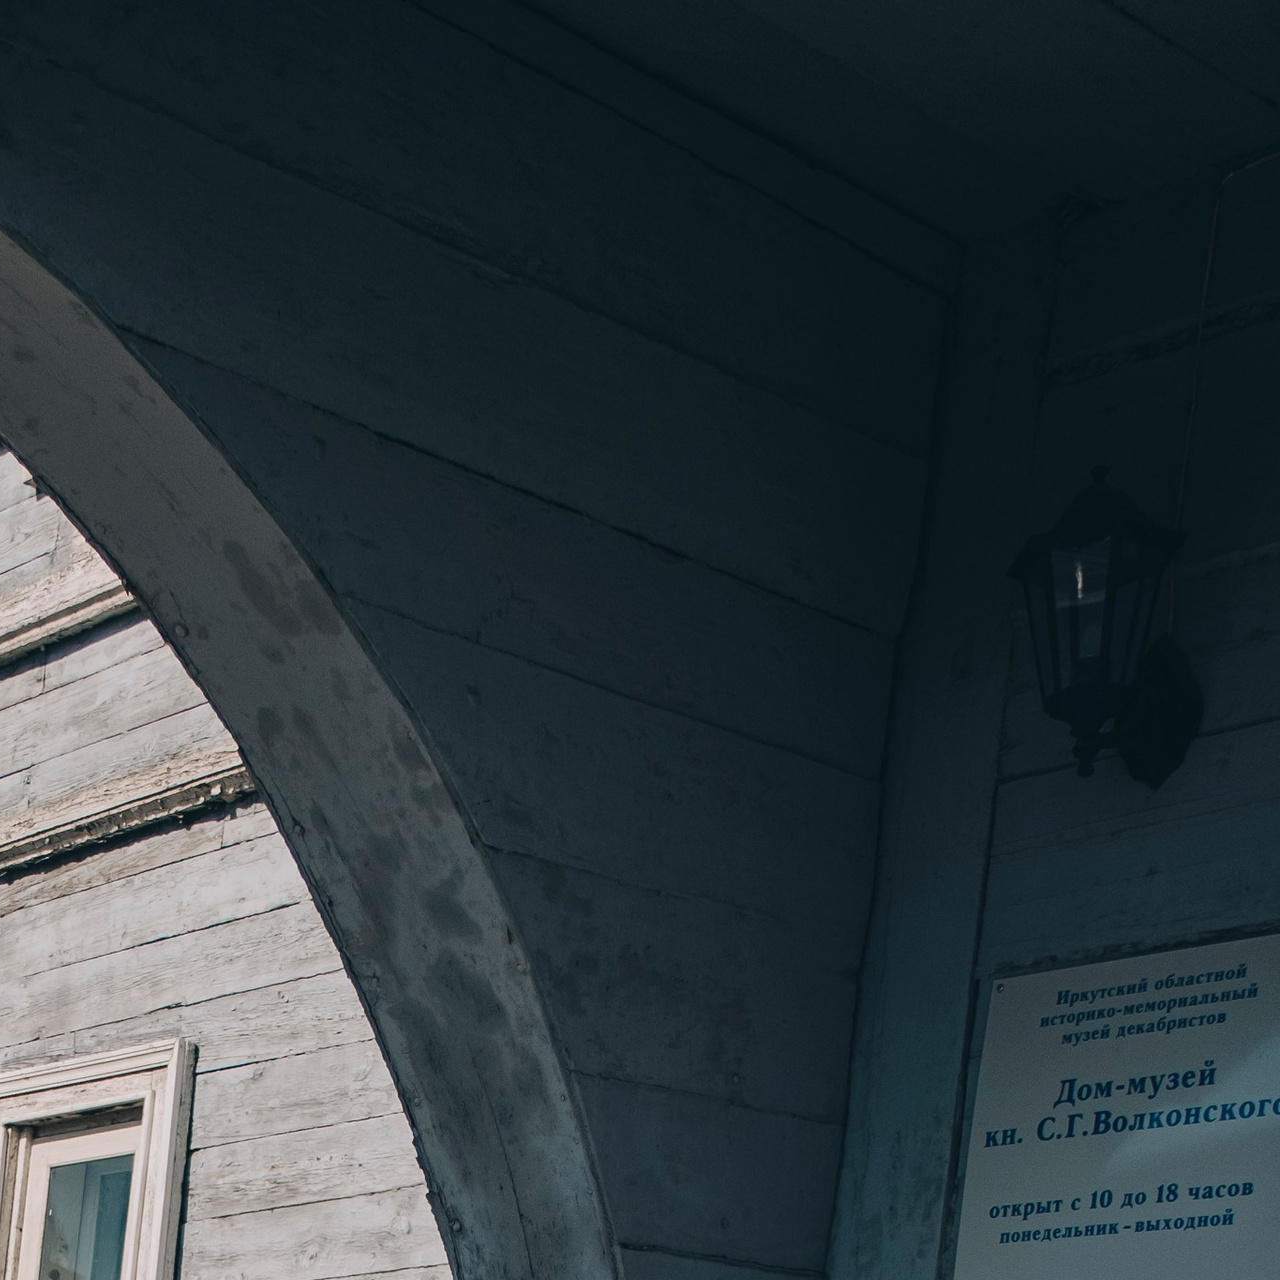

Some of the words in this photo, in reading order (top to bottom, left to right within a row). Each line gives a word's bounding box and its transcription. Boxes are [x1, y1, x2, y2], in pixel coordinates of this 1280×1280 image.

[1039, 983, 1259, 1028] историко-мемориальный
[1055, 978, 1148, 1007] Иркутский
[1154, 963, 1248, 992] областной
[1061, 1022, 1111, 1046] музей
[1115, 1011, 1227, 1039] декабристов
[1053, 1060, 1217, 1109] Дом-музей
[984, 1127, 1024, 1148] кн.
[989, 1200, 1063, 1221] открыт
[1070, 1198, 1081, 1211] с
[1089, 1189, 1113, 1209] 10
[1121, 1191, 1147, 1208] до
[1156, 1184, 1179, 1203] 18
[1188, 1182, 1254, 1201] часов
